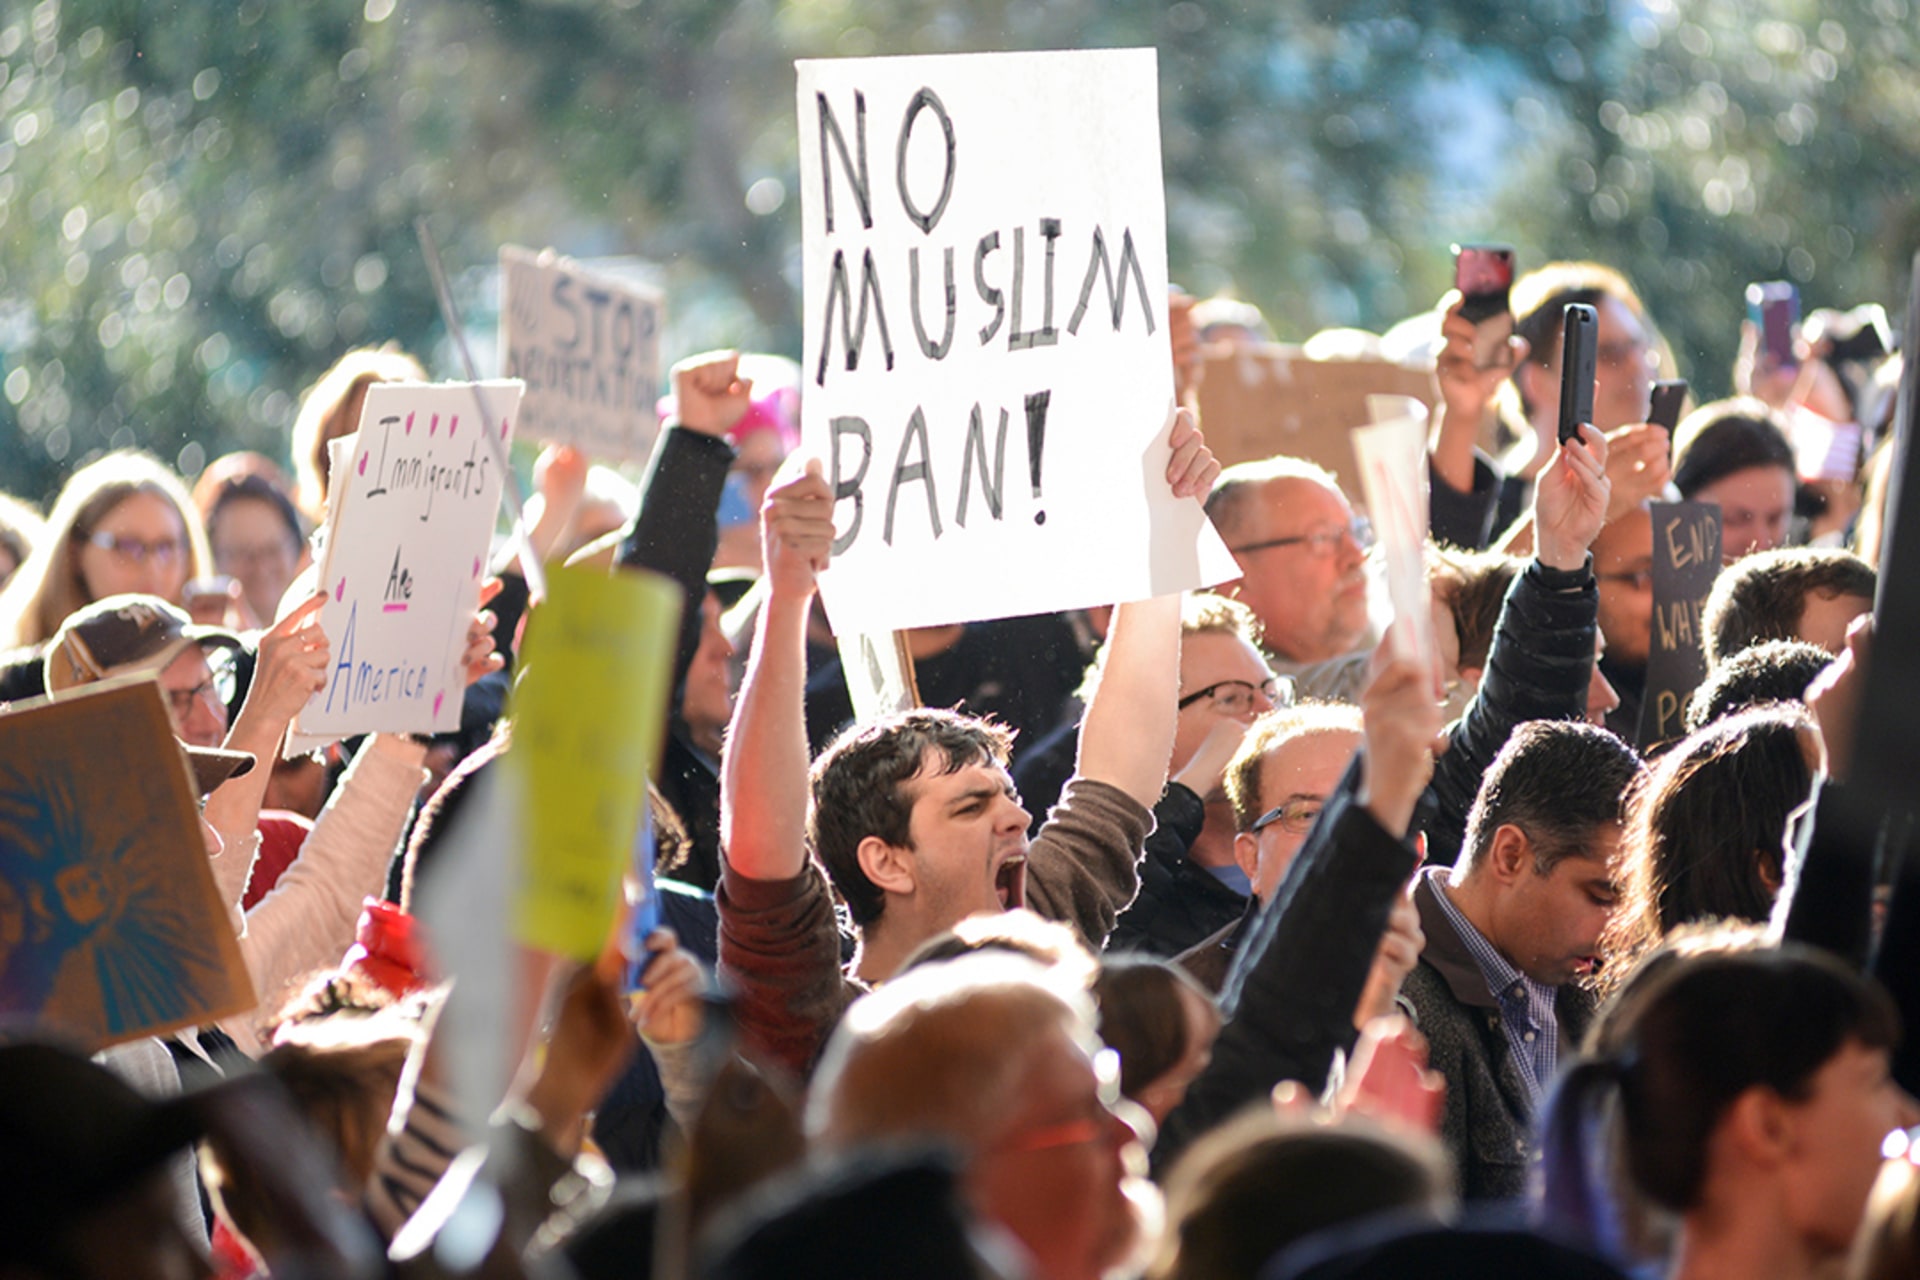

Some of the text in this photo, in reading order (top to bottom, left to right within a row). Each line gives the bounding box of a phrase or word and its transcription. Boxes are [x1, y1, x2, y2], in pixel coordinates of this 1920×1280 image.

[815, 86, 956, 235] NO
[553, 273, 656, 364] STOP
[816, 217, 1156, 388] MUSLIM
[366, 416, 490, 522] Immigrants
[829, 389, 1052, 557] BAN!
[1666, 514, 1717, 570] END
[325, 599, 427, 713] America
